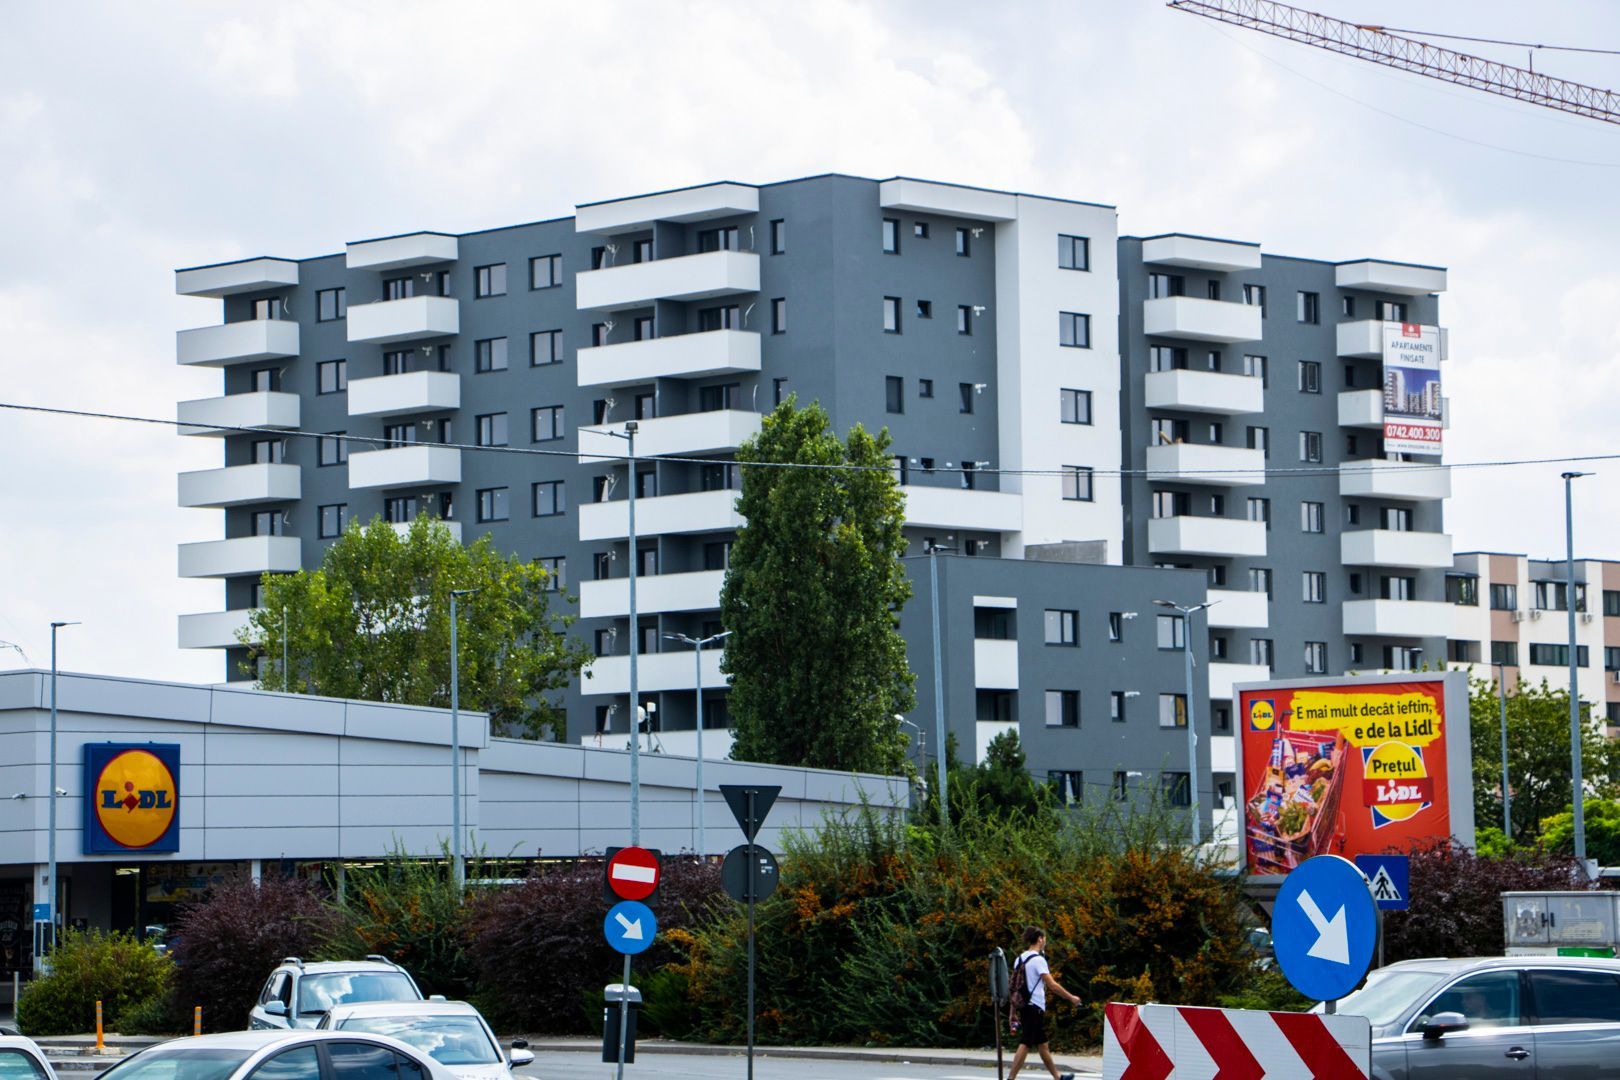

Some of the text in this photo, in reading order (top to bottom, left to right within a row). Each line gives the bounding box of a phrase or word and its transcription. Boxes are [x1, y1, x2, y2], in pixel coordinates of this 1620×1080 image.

[1391, 341, 1433, 352] APARTAMENTE
[1400, 353, 1425, 364] FINISATE
[1386, 424, 1440, 441] 0742.400.300
[1296, 699, 1433, 720] E mai mult decât ieftin,
[1354, 719, 1434, 740] e de la Lidl
[1372, 757, 1416, 776] Prețul
